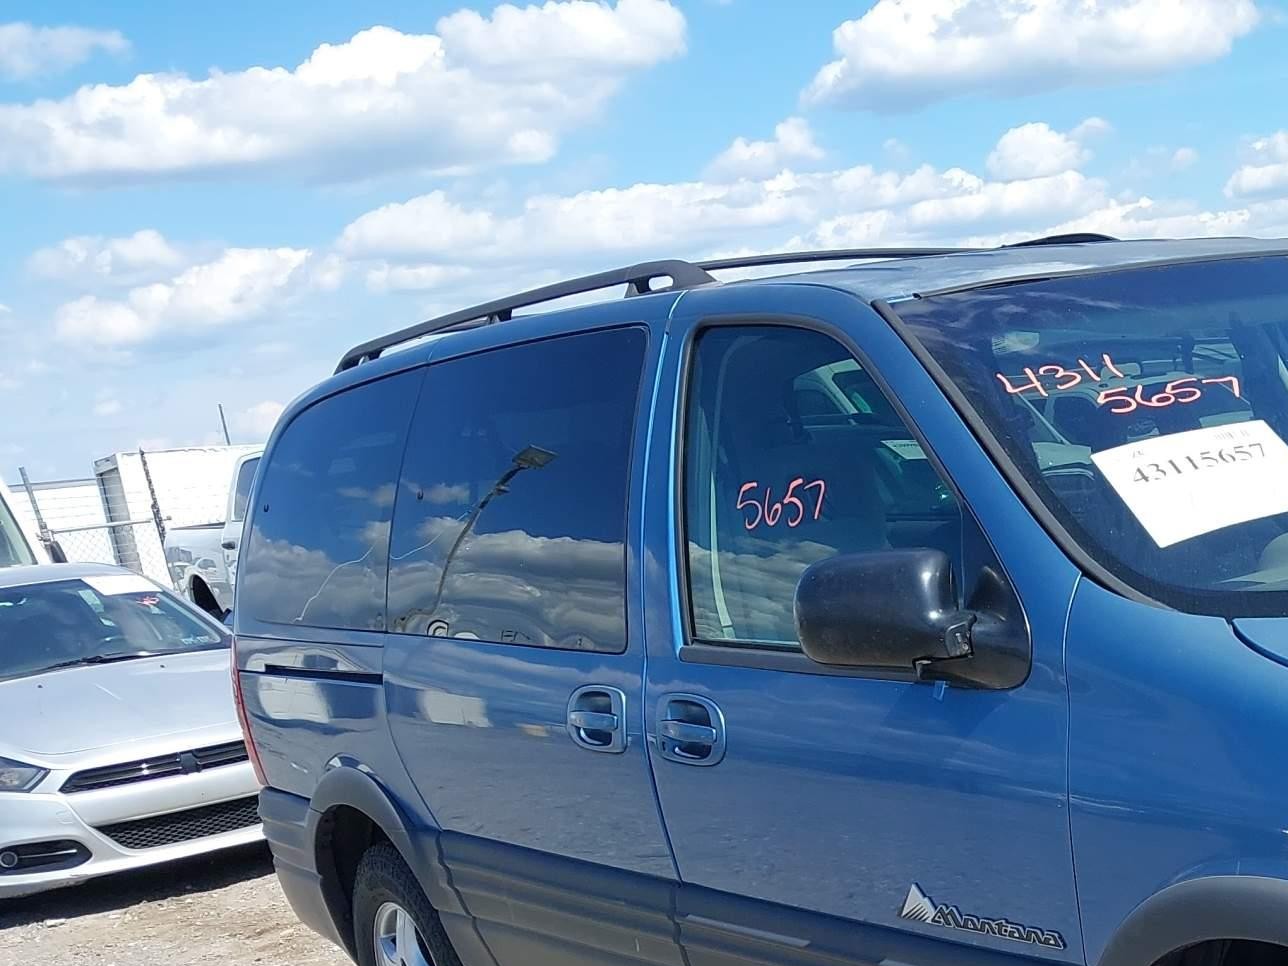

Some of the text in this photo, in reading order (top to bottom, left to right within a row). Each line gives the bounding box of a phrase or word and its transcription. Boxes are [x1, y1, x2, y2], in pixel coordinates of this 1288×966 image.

[996, 354, 1124, 397] 4311
[1097, 376, 1242, 413] 5657
[1133, 442, 1265, 482] 43115657
[736, 478, 825, 530] 5657
[930, 904, 1066, 950] Montana
